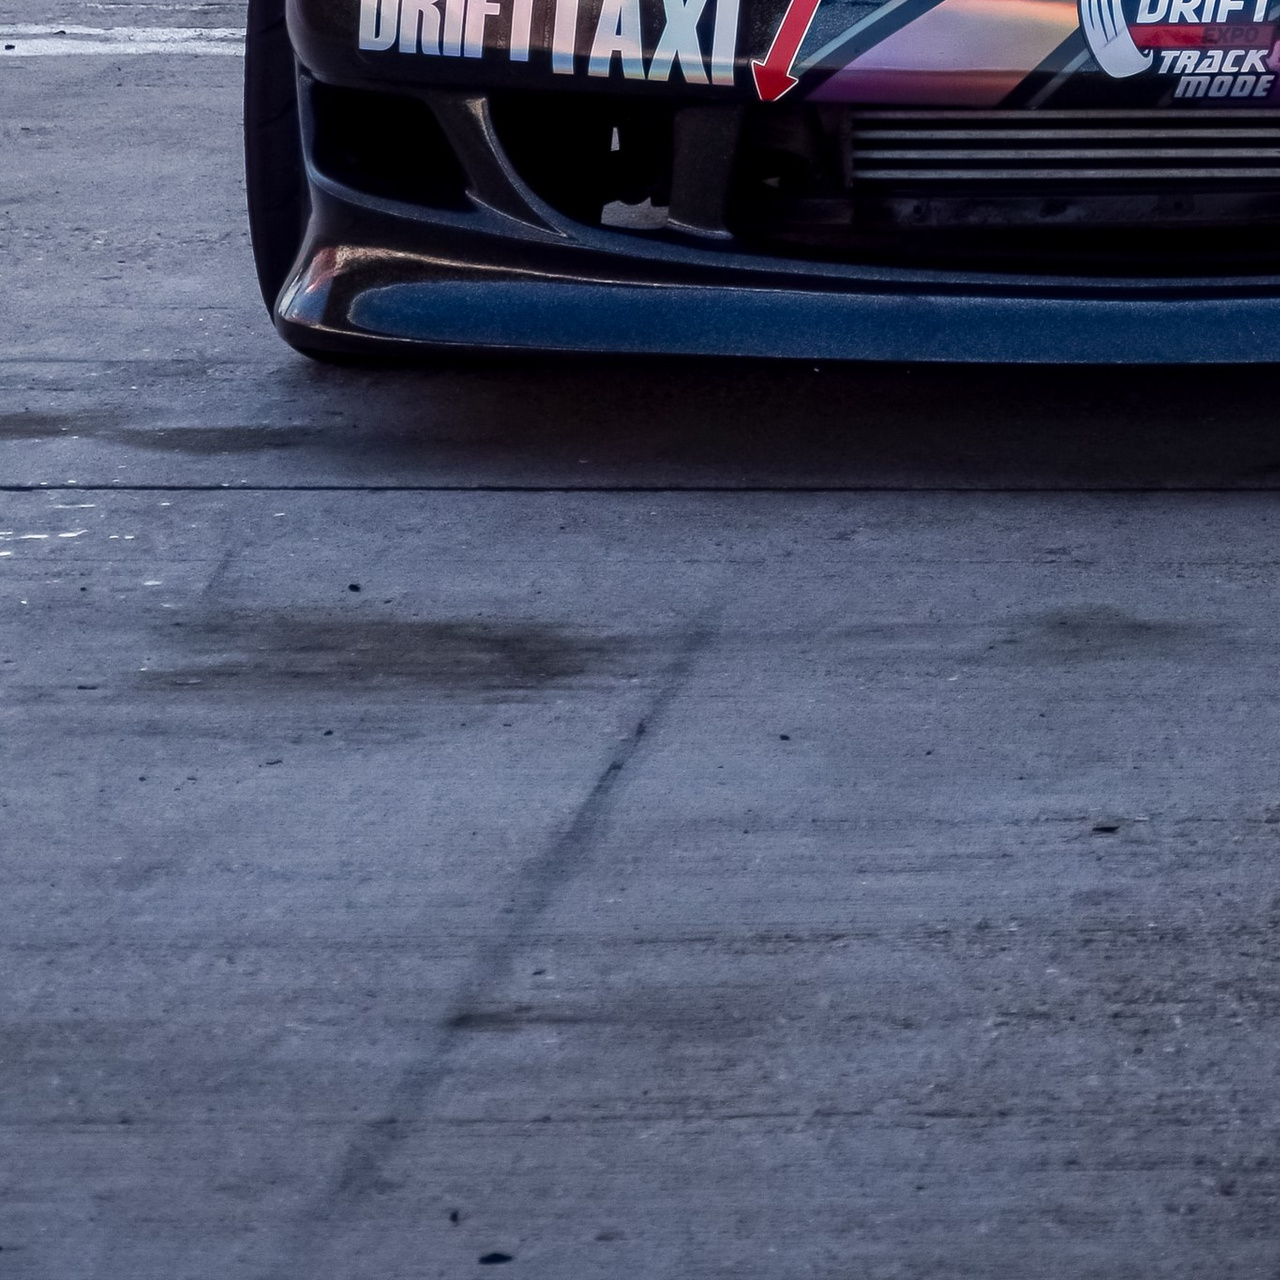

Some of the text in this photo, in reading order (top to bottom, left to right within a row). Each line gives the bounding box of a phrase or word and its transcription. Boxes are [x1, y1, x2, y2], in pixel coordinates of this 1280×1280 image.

[1203, 26, 1260, 44] EXPO
[1157, 49, 1270, 74] TRACK
[1173, 74, 1276, 99] MODE
